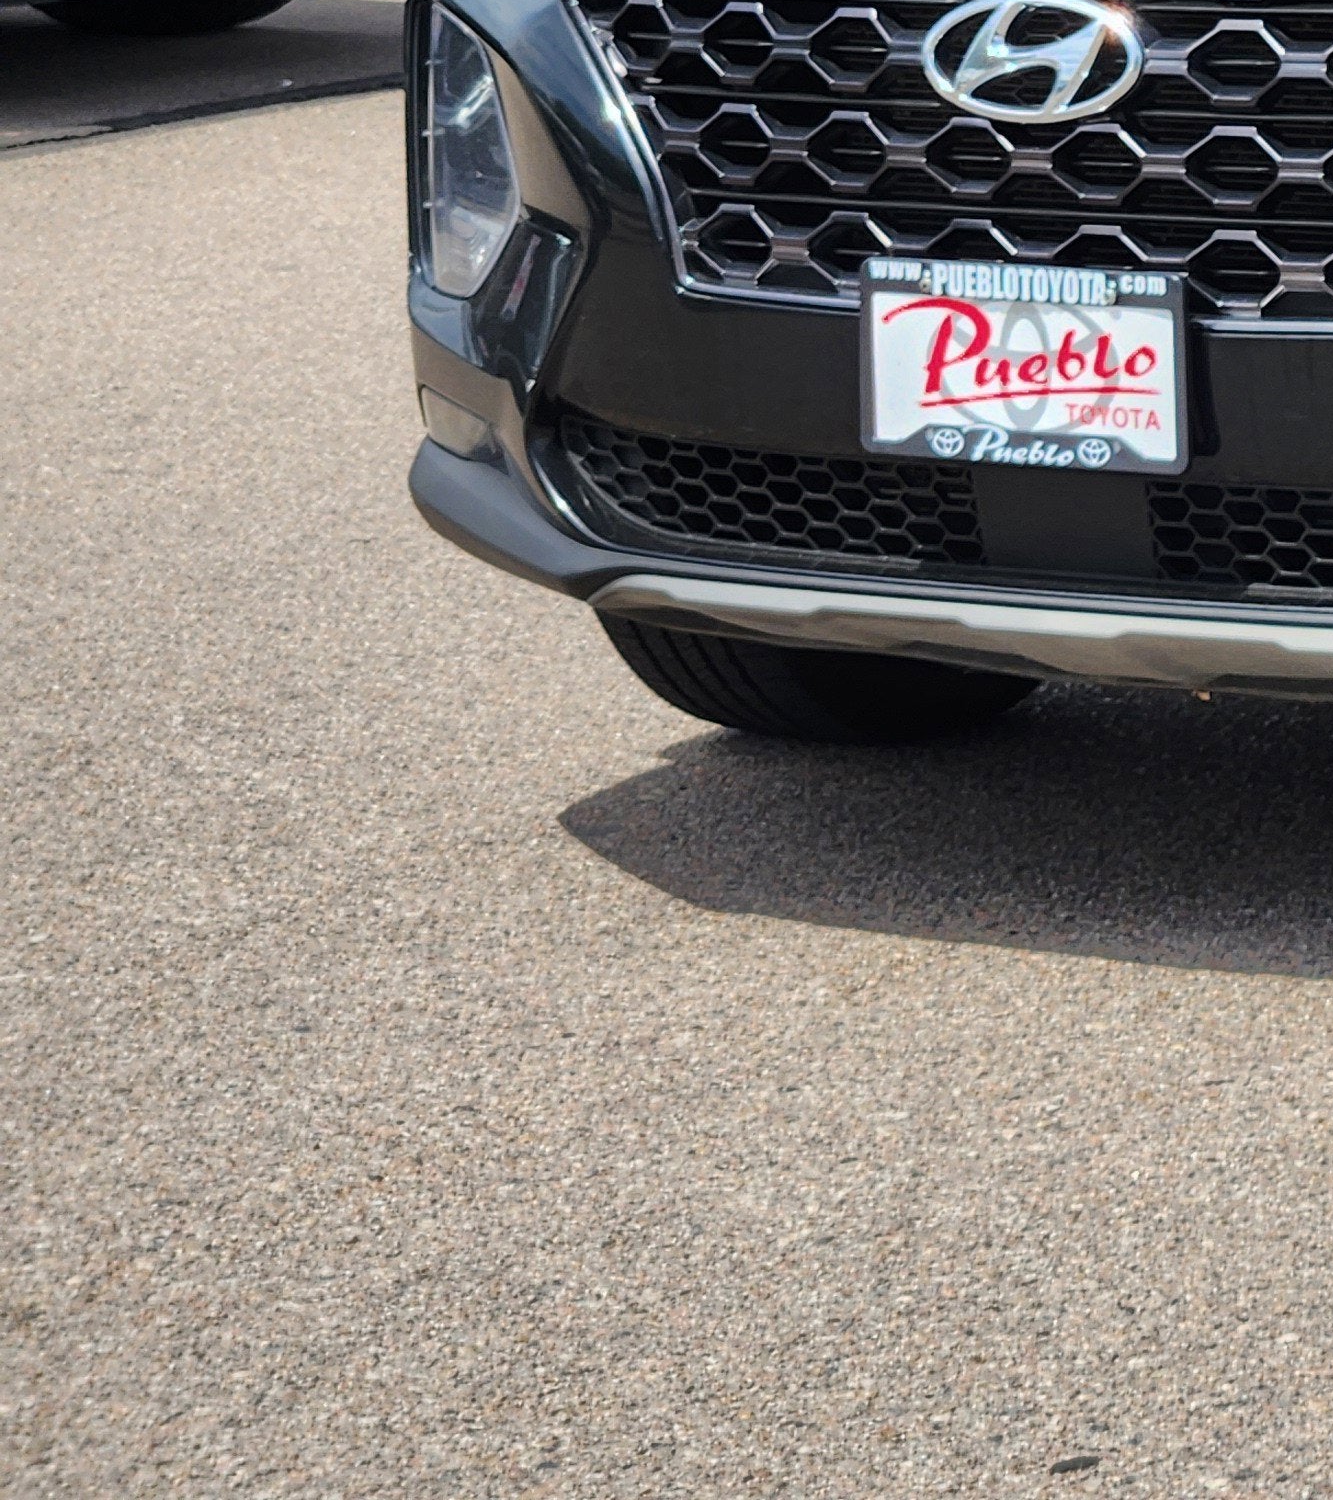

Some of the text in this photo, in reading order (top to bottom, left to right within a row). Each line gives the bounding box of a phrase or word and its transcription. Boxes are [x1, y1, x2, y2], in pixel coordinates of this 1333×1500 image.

[882, 297, 1158, 394] Pueblo
[1066, 403, 1161, 430] TOYOTA
[961, 423, 1075, 467] Pueblo
